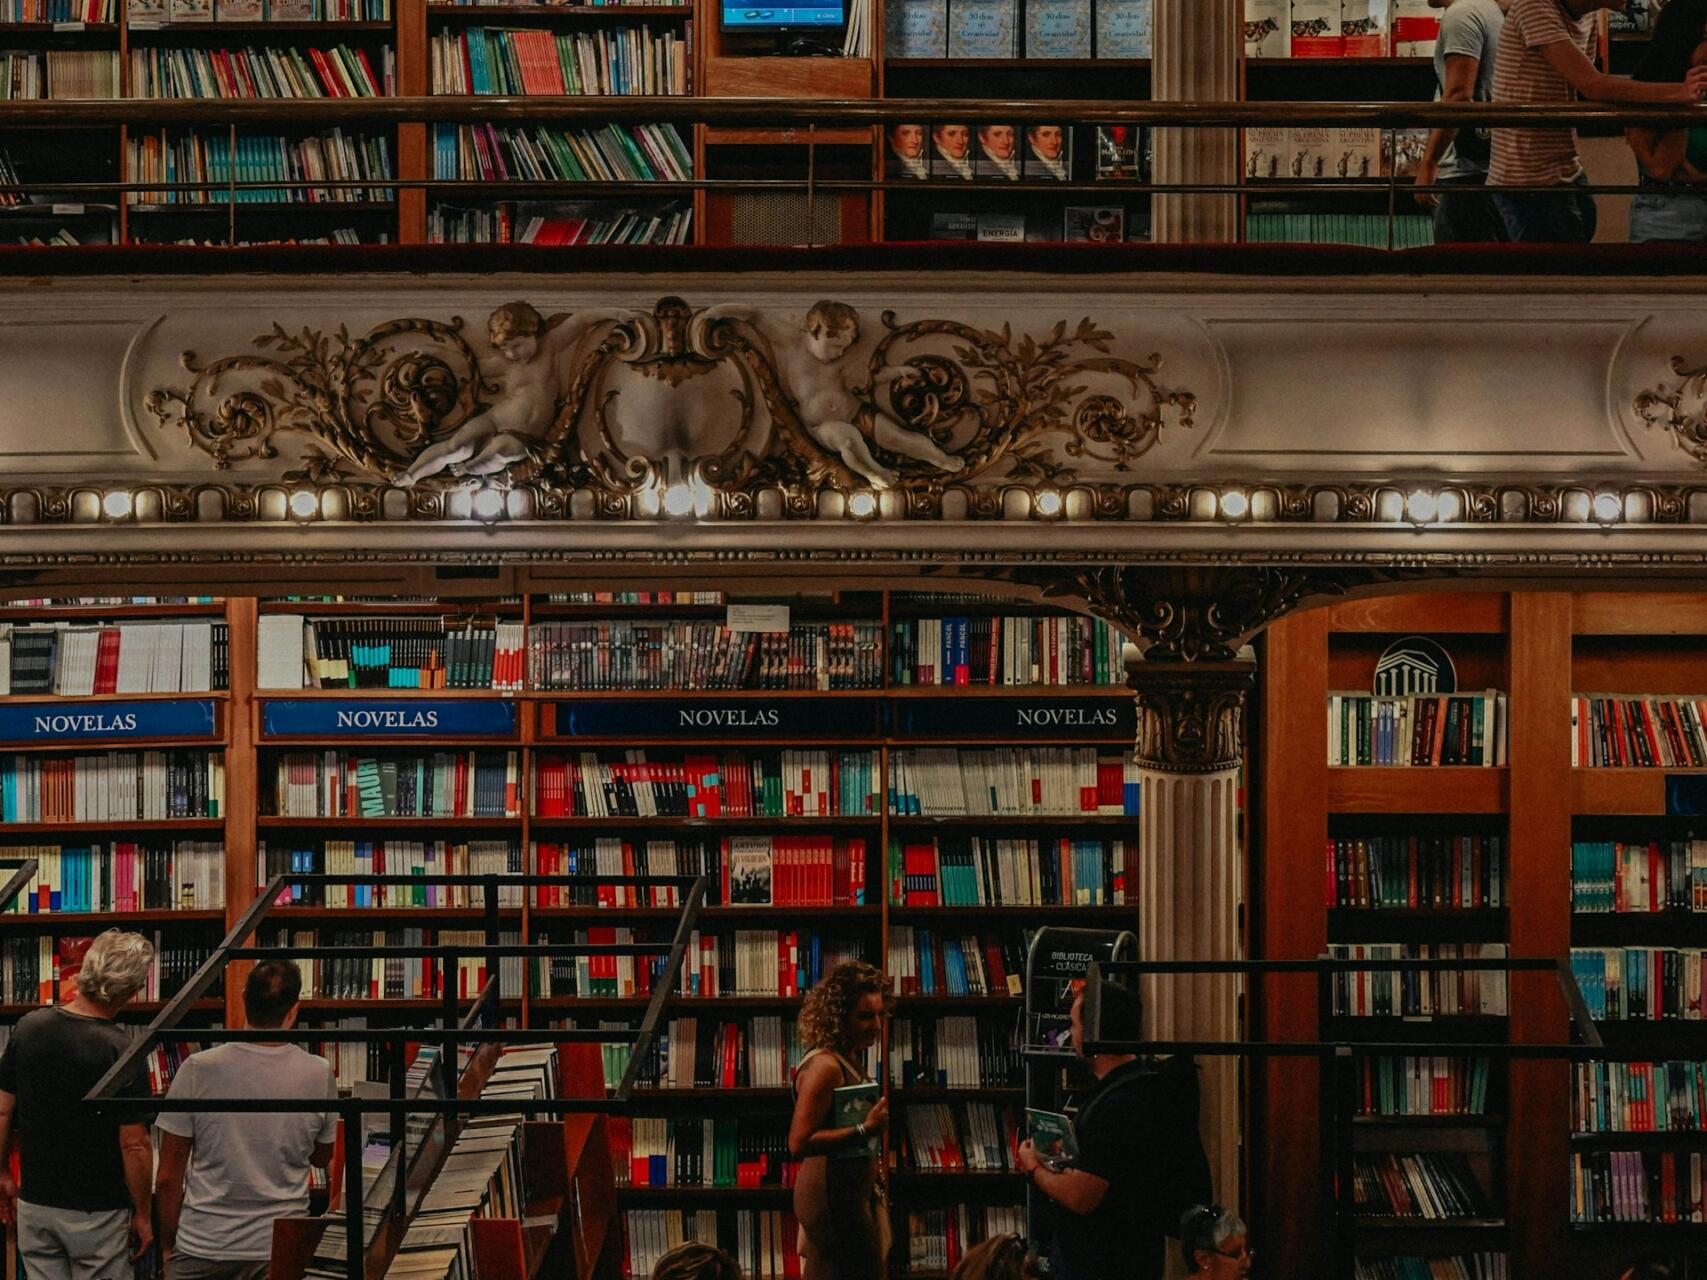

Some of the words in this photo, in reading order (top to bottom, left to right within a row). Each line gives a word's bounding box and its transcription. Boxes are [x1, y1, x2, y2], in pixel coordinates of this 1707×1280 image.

[983, 227, 1018, 237] ENERGÍA
[34, 713, 137, 733] NOVELAS
[337, 710, 439, 728] NOVELAS
[679, 709, 779, 726] NOVELAS
[1017, 708, 1117, 726] NOVELAS
[1051, 951, 1093, 961] BIBLIOTECA
